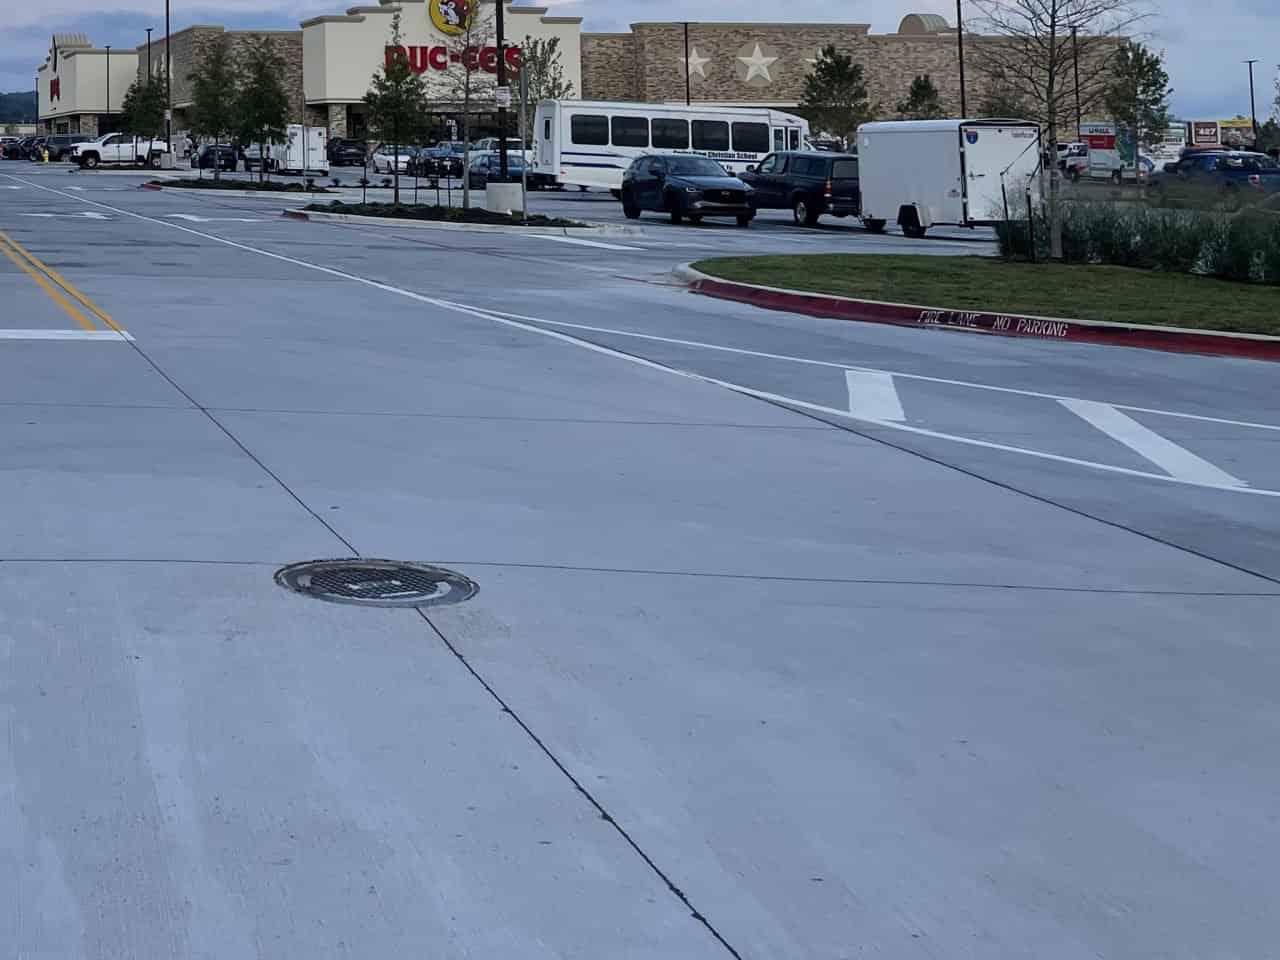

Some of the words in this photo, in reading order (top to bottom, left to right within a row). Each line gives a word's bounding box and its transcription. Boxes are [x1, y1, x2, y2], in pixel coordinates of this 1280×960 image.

[917, 310, 945, 324] FIRE
[948, 311, 981, 327] LANE
[992, 316, 1012, 330] NO
[1016, 318, 1069, 337] PARKING
